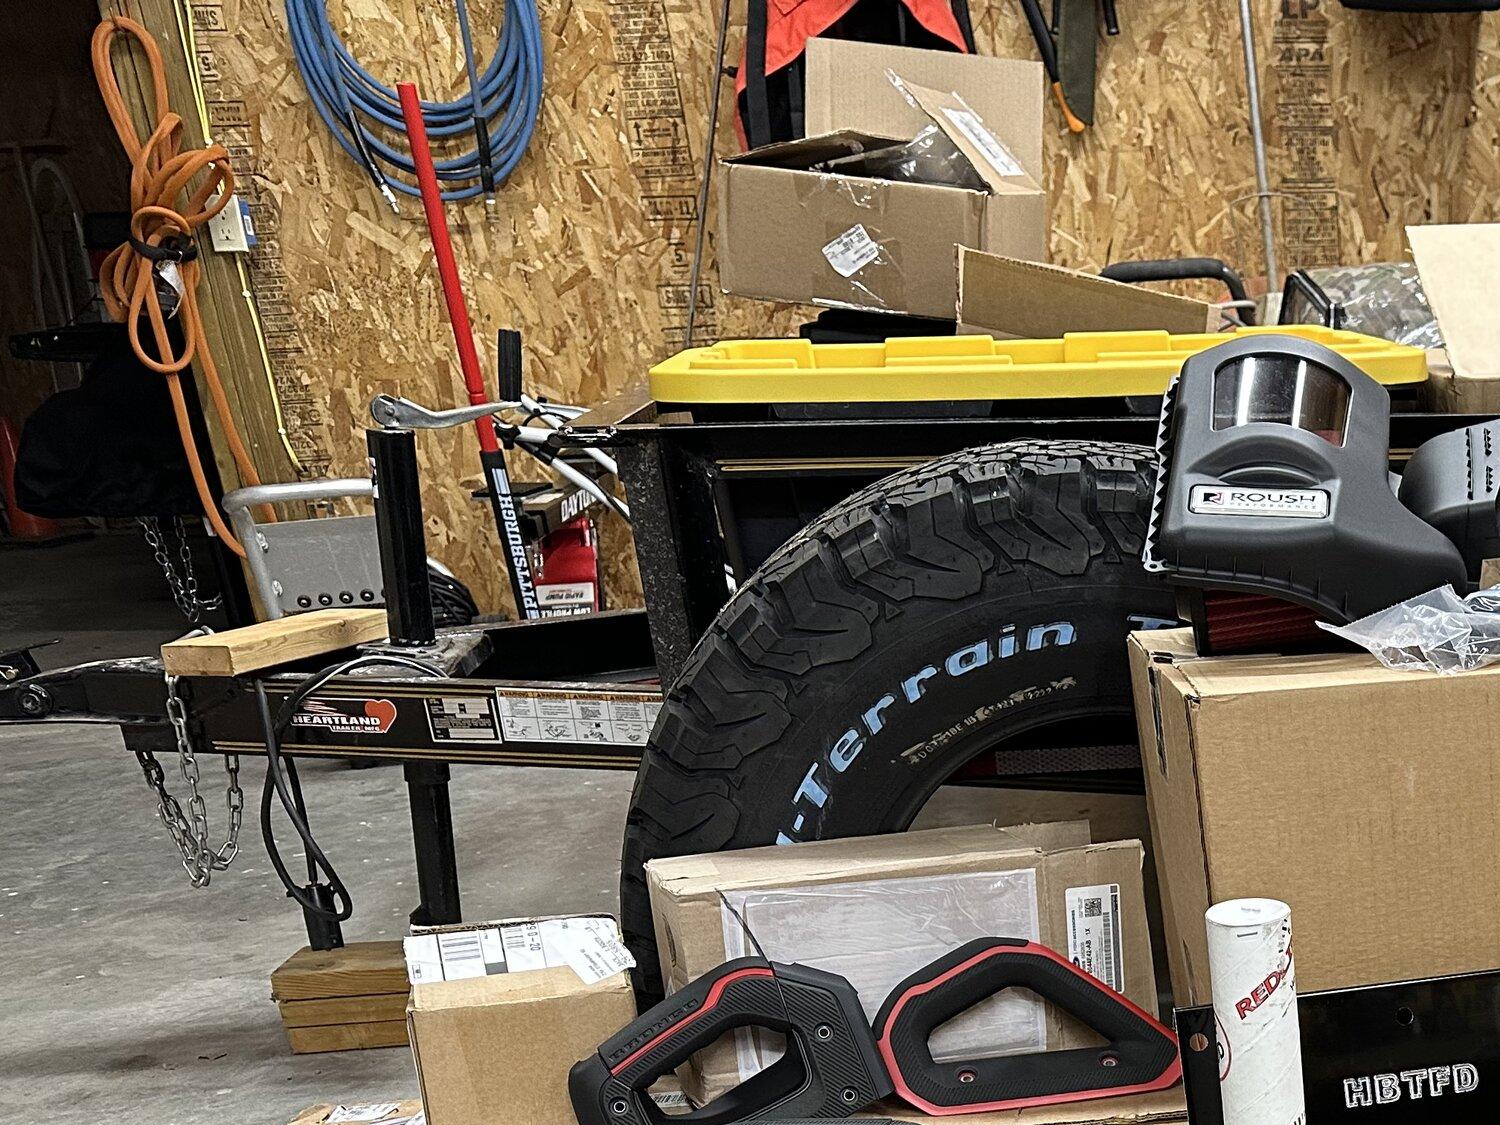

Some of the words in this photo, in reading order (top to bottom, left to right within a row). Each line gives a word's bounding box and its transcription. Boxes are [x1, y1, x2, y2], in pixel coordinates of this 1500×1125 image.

[1279, 47, 1324, 61] APA
[1231, 492, 1316, 504] ROUSH
[498, 495, 540, 609] PITTSBURGH
[292, 715, 381, 728] HEARTLAND
[1343, 1062, 1479, 1108] HBTFD
